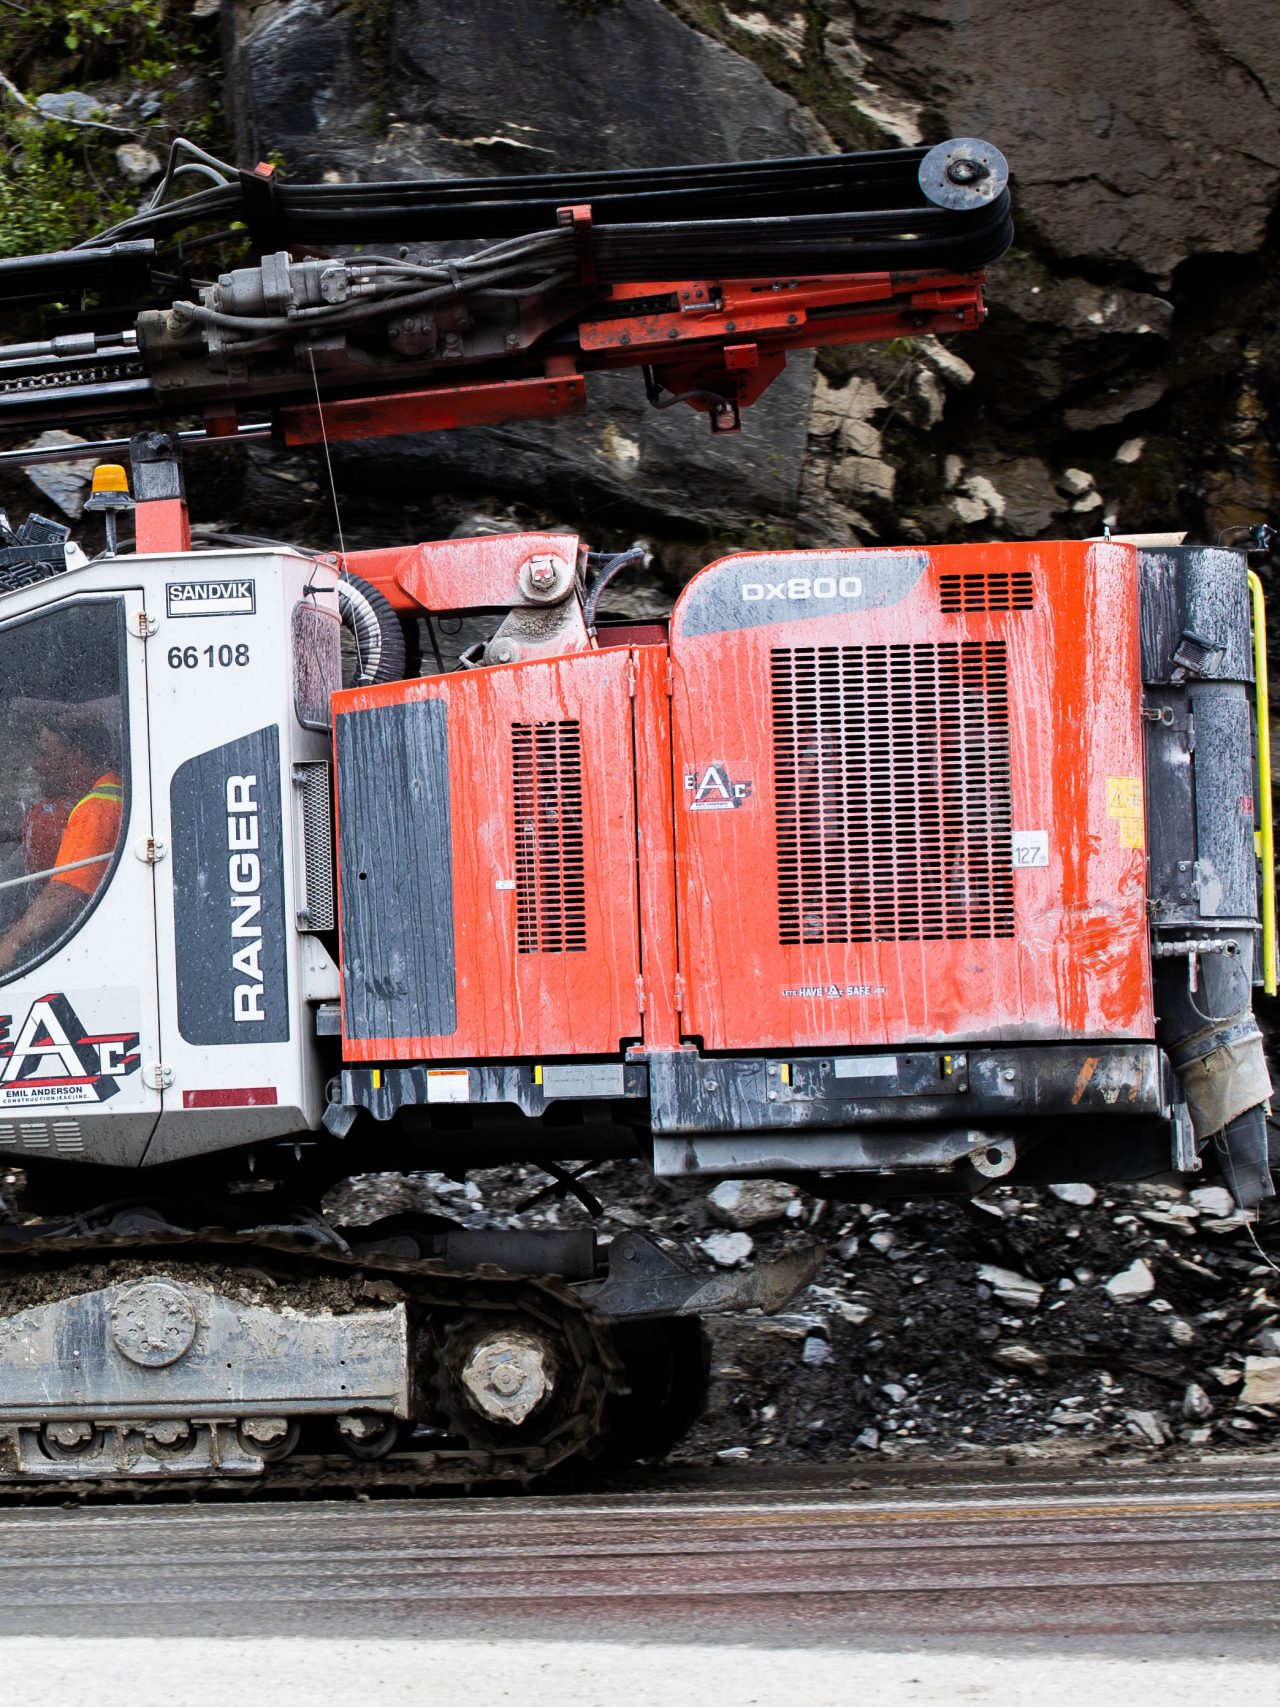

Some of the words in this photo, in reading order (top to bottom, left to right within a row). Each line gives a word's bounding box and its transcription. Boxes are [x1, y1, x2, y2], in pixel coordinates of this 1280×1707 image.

[170, 582, 251, 601] SANDVIK
[741, 576, 862, 601] DX800
[1015, 846, 1041, 864] 127
[226, 774, 265, 1023] RANGER
[799, 987, 823, 997] HAVE
[846, 986, 871, 996] SAFE
[2, 1096, 55, 1104] CONSTRUCTION
[6, 1090, 29, 1098] EMIL
[31, 1086, 83, 1096] ANDERSON
